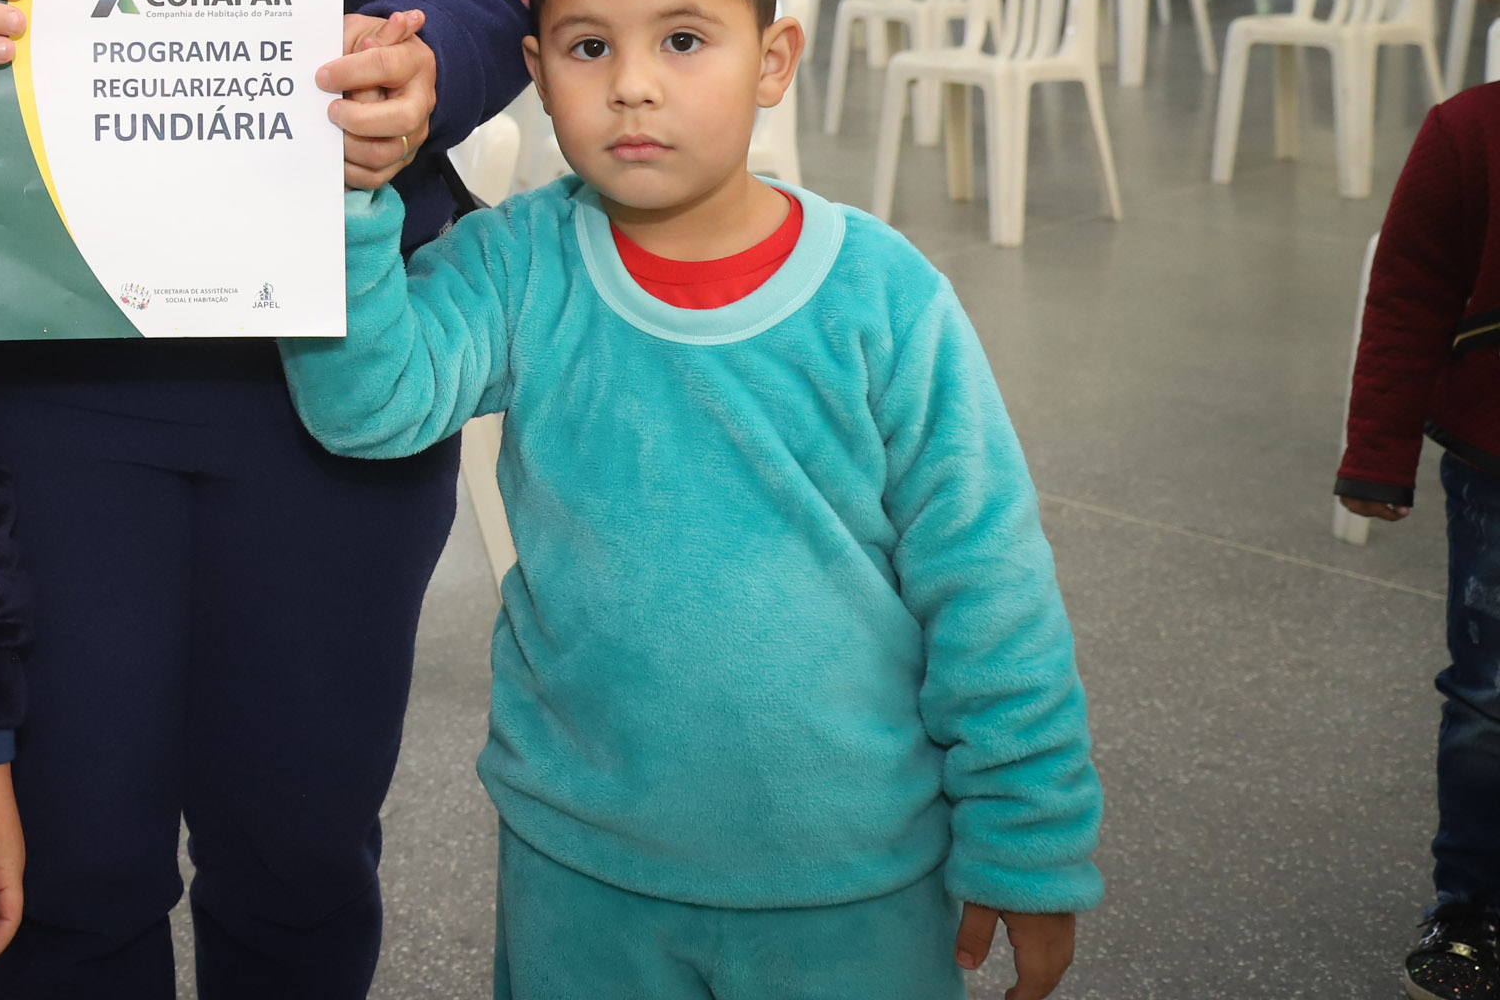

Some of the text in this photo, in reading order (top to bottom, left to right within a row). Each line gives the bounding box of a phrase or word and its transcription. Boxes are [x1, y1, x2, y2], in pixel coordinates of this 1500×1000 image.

[146, 10, 192, 19] Companhia
[207, 10, 249, 18] Habitação
[264, 9, 293, 17] Paraná
[93, 41, 293, 63] PROGRAMA DE
[93, 72, 295, 101] REGULARIZAÇÃO
[94, 104, 293, 142] FUNDIÁRIA
[252, 301, 280, 309] JAPEL
